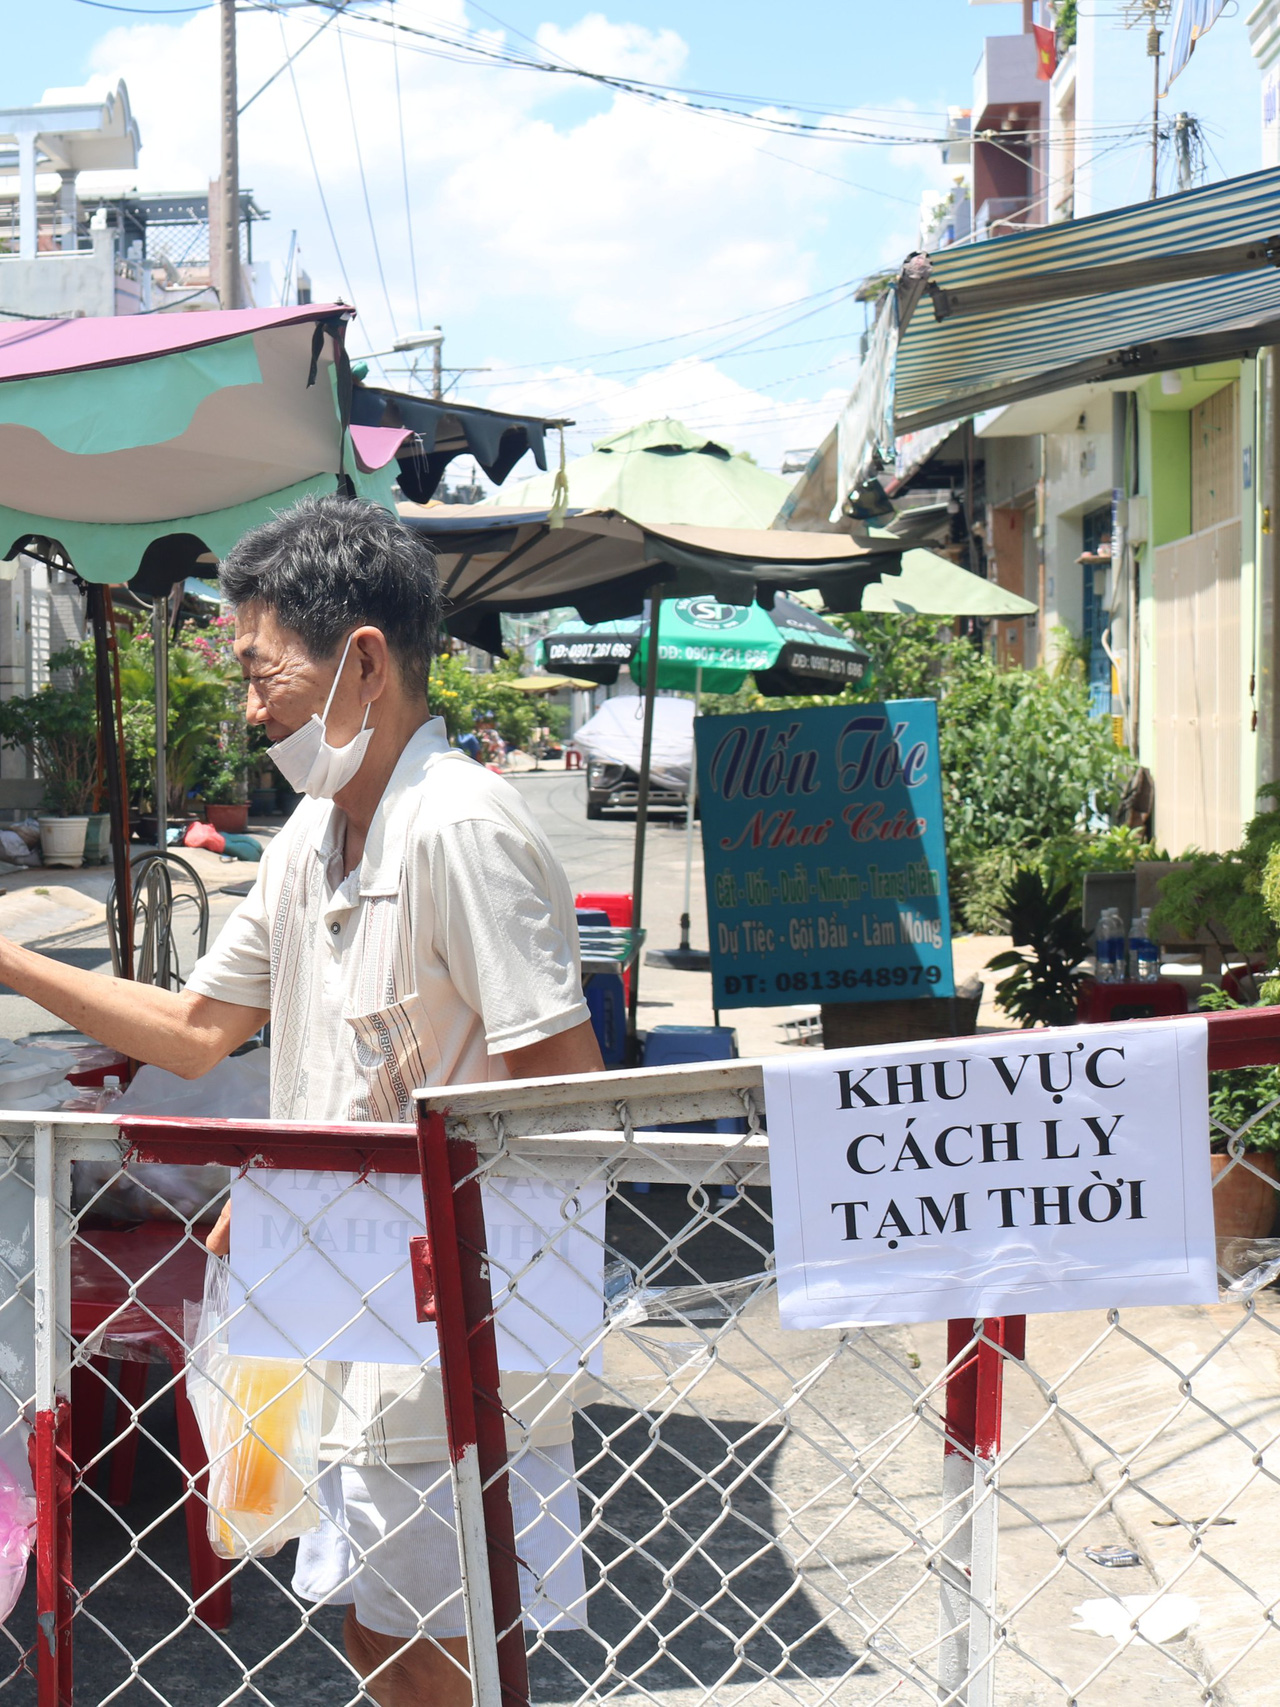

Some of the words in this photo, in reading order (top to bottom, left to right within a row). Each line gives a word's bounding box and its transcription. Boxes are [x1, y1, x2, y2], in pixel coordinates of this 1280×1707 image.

[696, 603, 728, 619] ST
[711, 722, 820, 800] Uốn
[836, 716, 928, 793] Tóc
[721, 808, 834, 850] Như
[842, 802, 927, 842] Cúc
[867, 863, 906, 904] Trang
[742, 920, 776, 960] Tiệc
[789, 917, 815, 958] Gội
[818, 911, 848, 949] Đầu
[862, 913, 896, 947] Làm
[899, 910, 943, 950] Móng
[724, 973, 767, 995] ĐT:
[775, 965, 942, 993] 0813648979
[833, 1058, 972, 1110] KHU
[988, 1042, 1126, 1105] VỰC
[846, 1117, 1024, 1175] CÁCH
[1040, 1114, 1125, 1160] LY
[831, 1191, 972, 1250] TẠM
[987, 1170, 1147, 1229] THỜI
